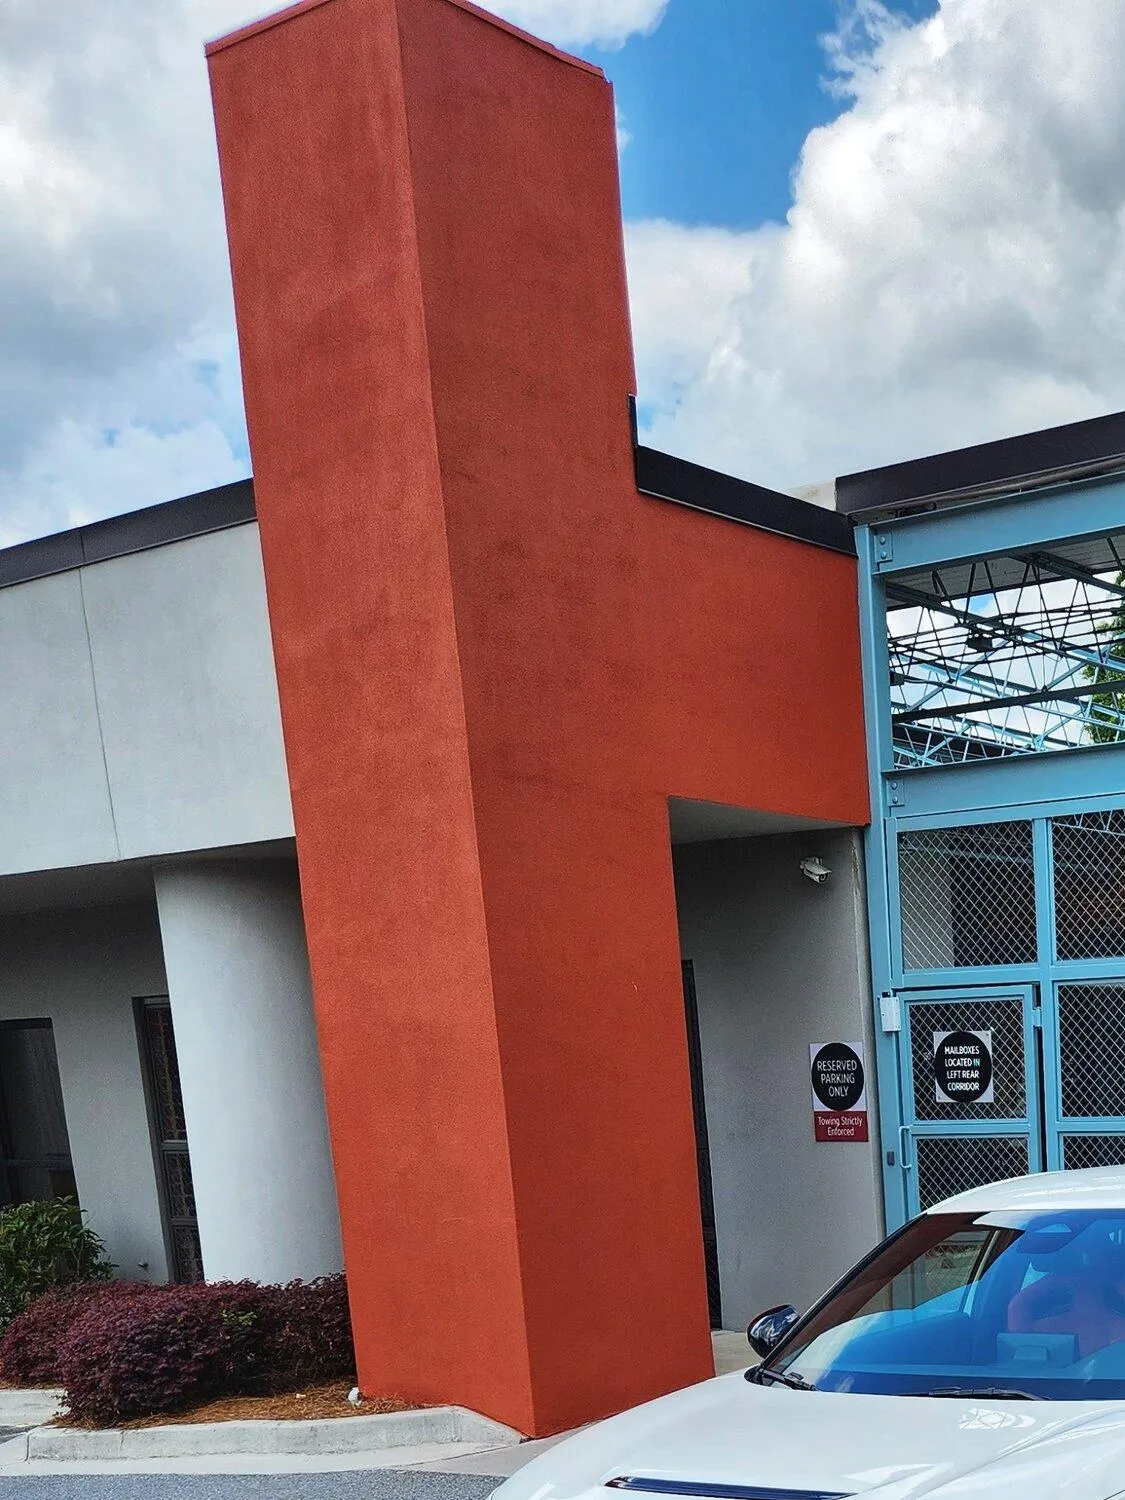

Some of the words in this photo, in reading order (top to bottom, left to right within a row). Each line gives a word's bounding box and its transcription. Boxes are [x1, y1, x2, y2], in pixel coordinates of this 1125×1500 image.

[944, 1045, 980, 1055] MAILBOXES
[817, 1060, 858, 1072] RESERVED
[944, 1058, 973, 1067] LOCATED
[973, 1058, 981, 1067] IN
[820, 1073, 856, 1085] PARKING
[946, 1070, 961, 1079] LEFT
[962, 1070, 980, 1079] REAR
[828, 1086, 849, 1097] ONLY
[947, 1082, 980, 1091] CORRIDOR
[817, 1116, 840, 1127] Towing
[841, 1116, 863, 1127] Strictly
[827, 1127, 855, 1137] Enforced
